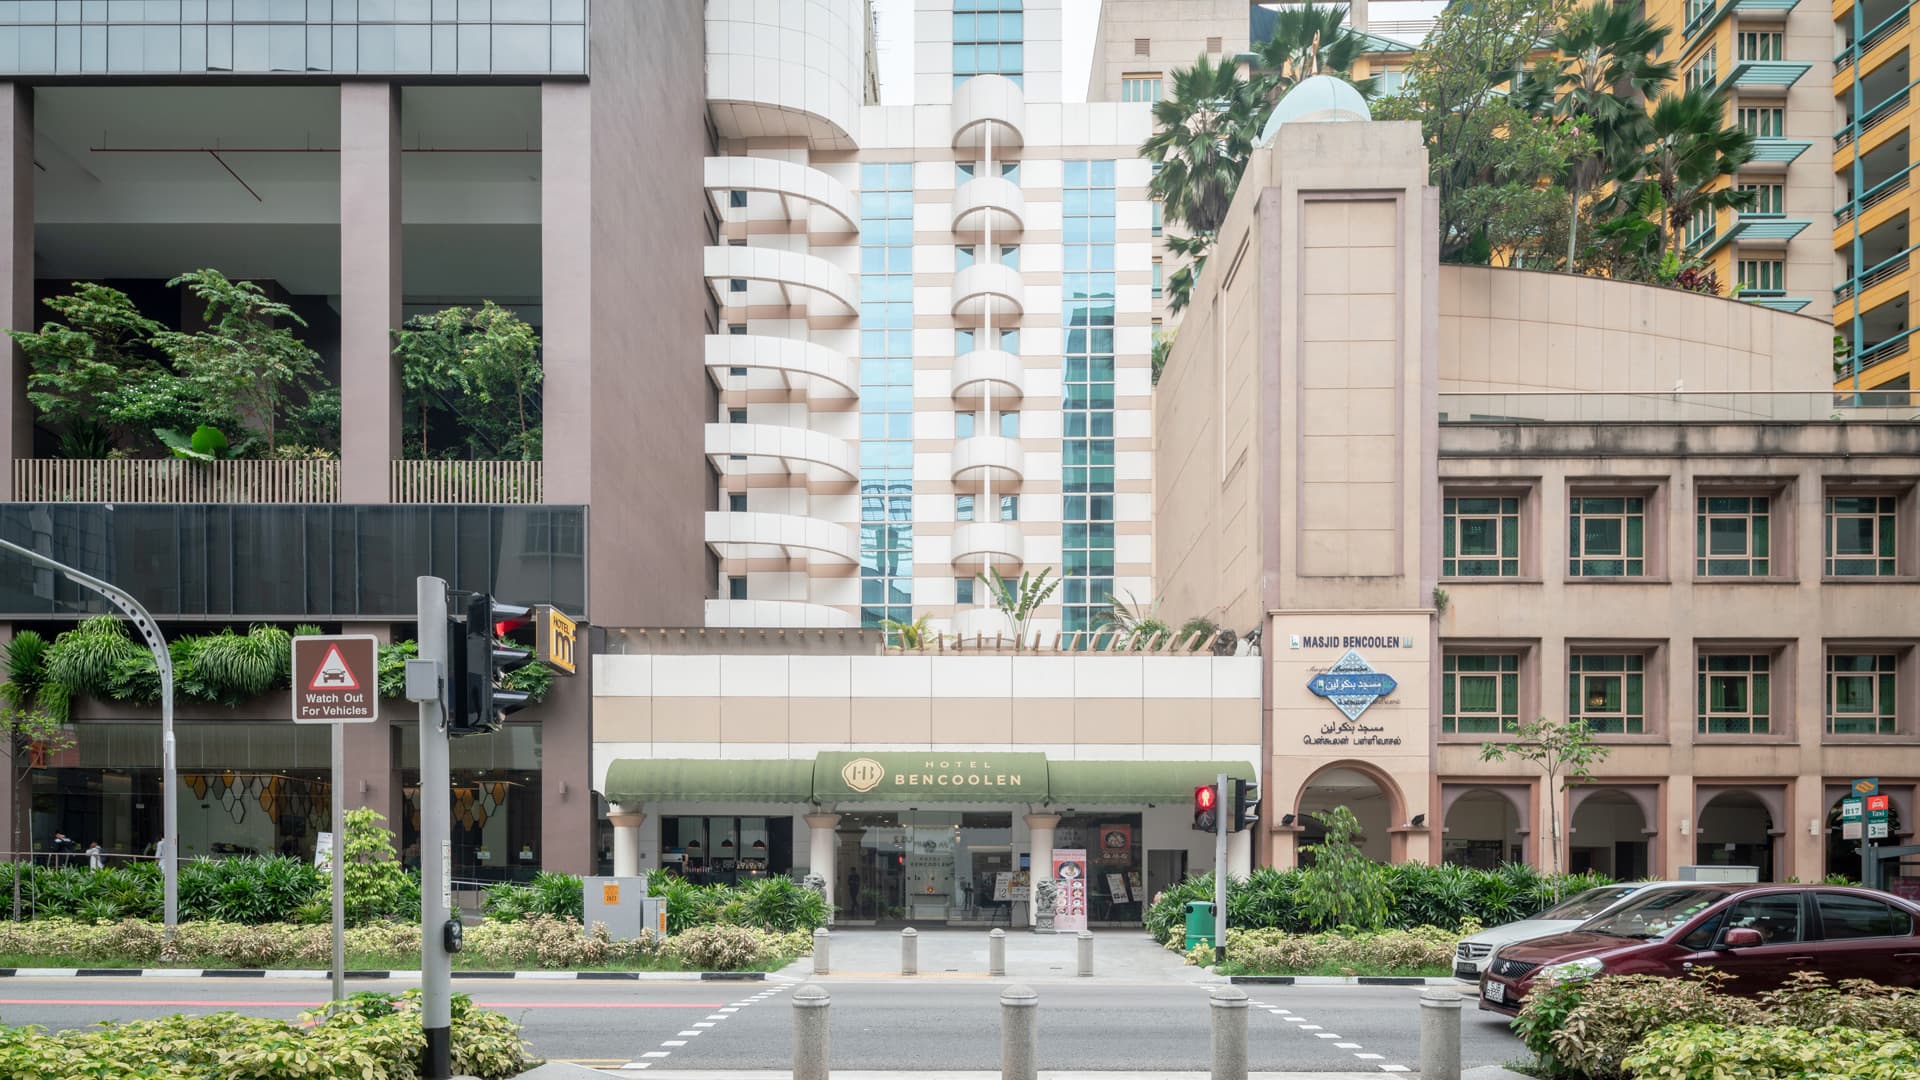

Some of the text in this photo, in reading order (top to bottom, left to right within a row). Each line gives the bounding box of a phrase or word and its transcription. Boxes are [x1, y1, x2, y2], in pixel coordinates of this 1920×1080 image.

[554, 616, 570, 635] HOTEL
[1303, 636, 1400, 649] MASJID BENCOOLEN
[305, 692, 364, 703] Watch Out
[302, 705, 368, 716] For Vehicles
[925, 761, 992, 769] HOTEL
[895, 774, 1022, 786] BENCOOLEN
